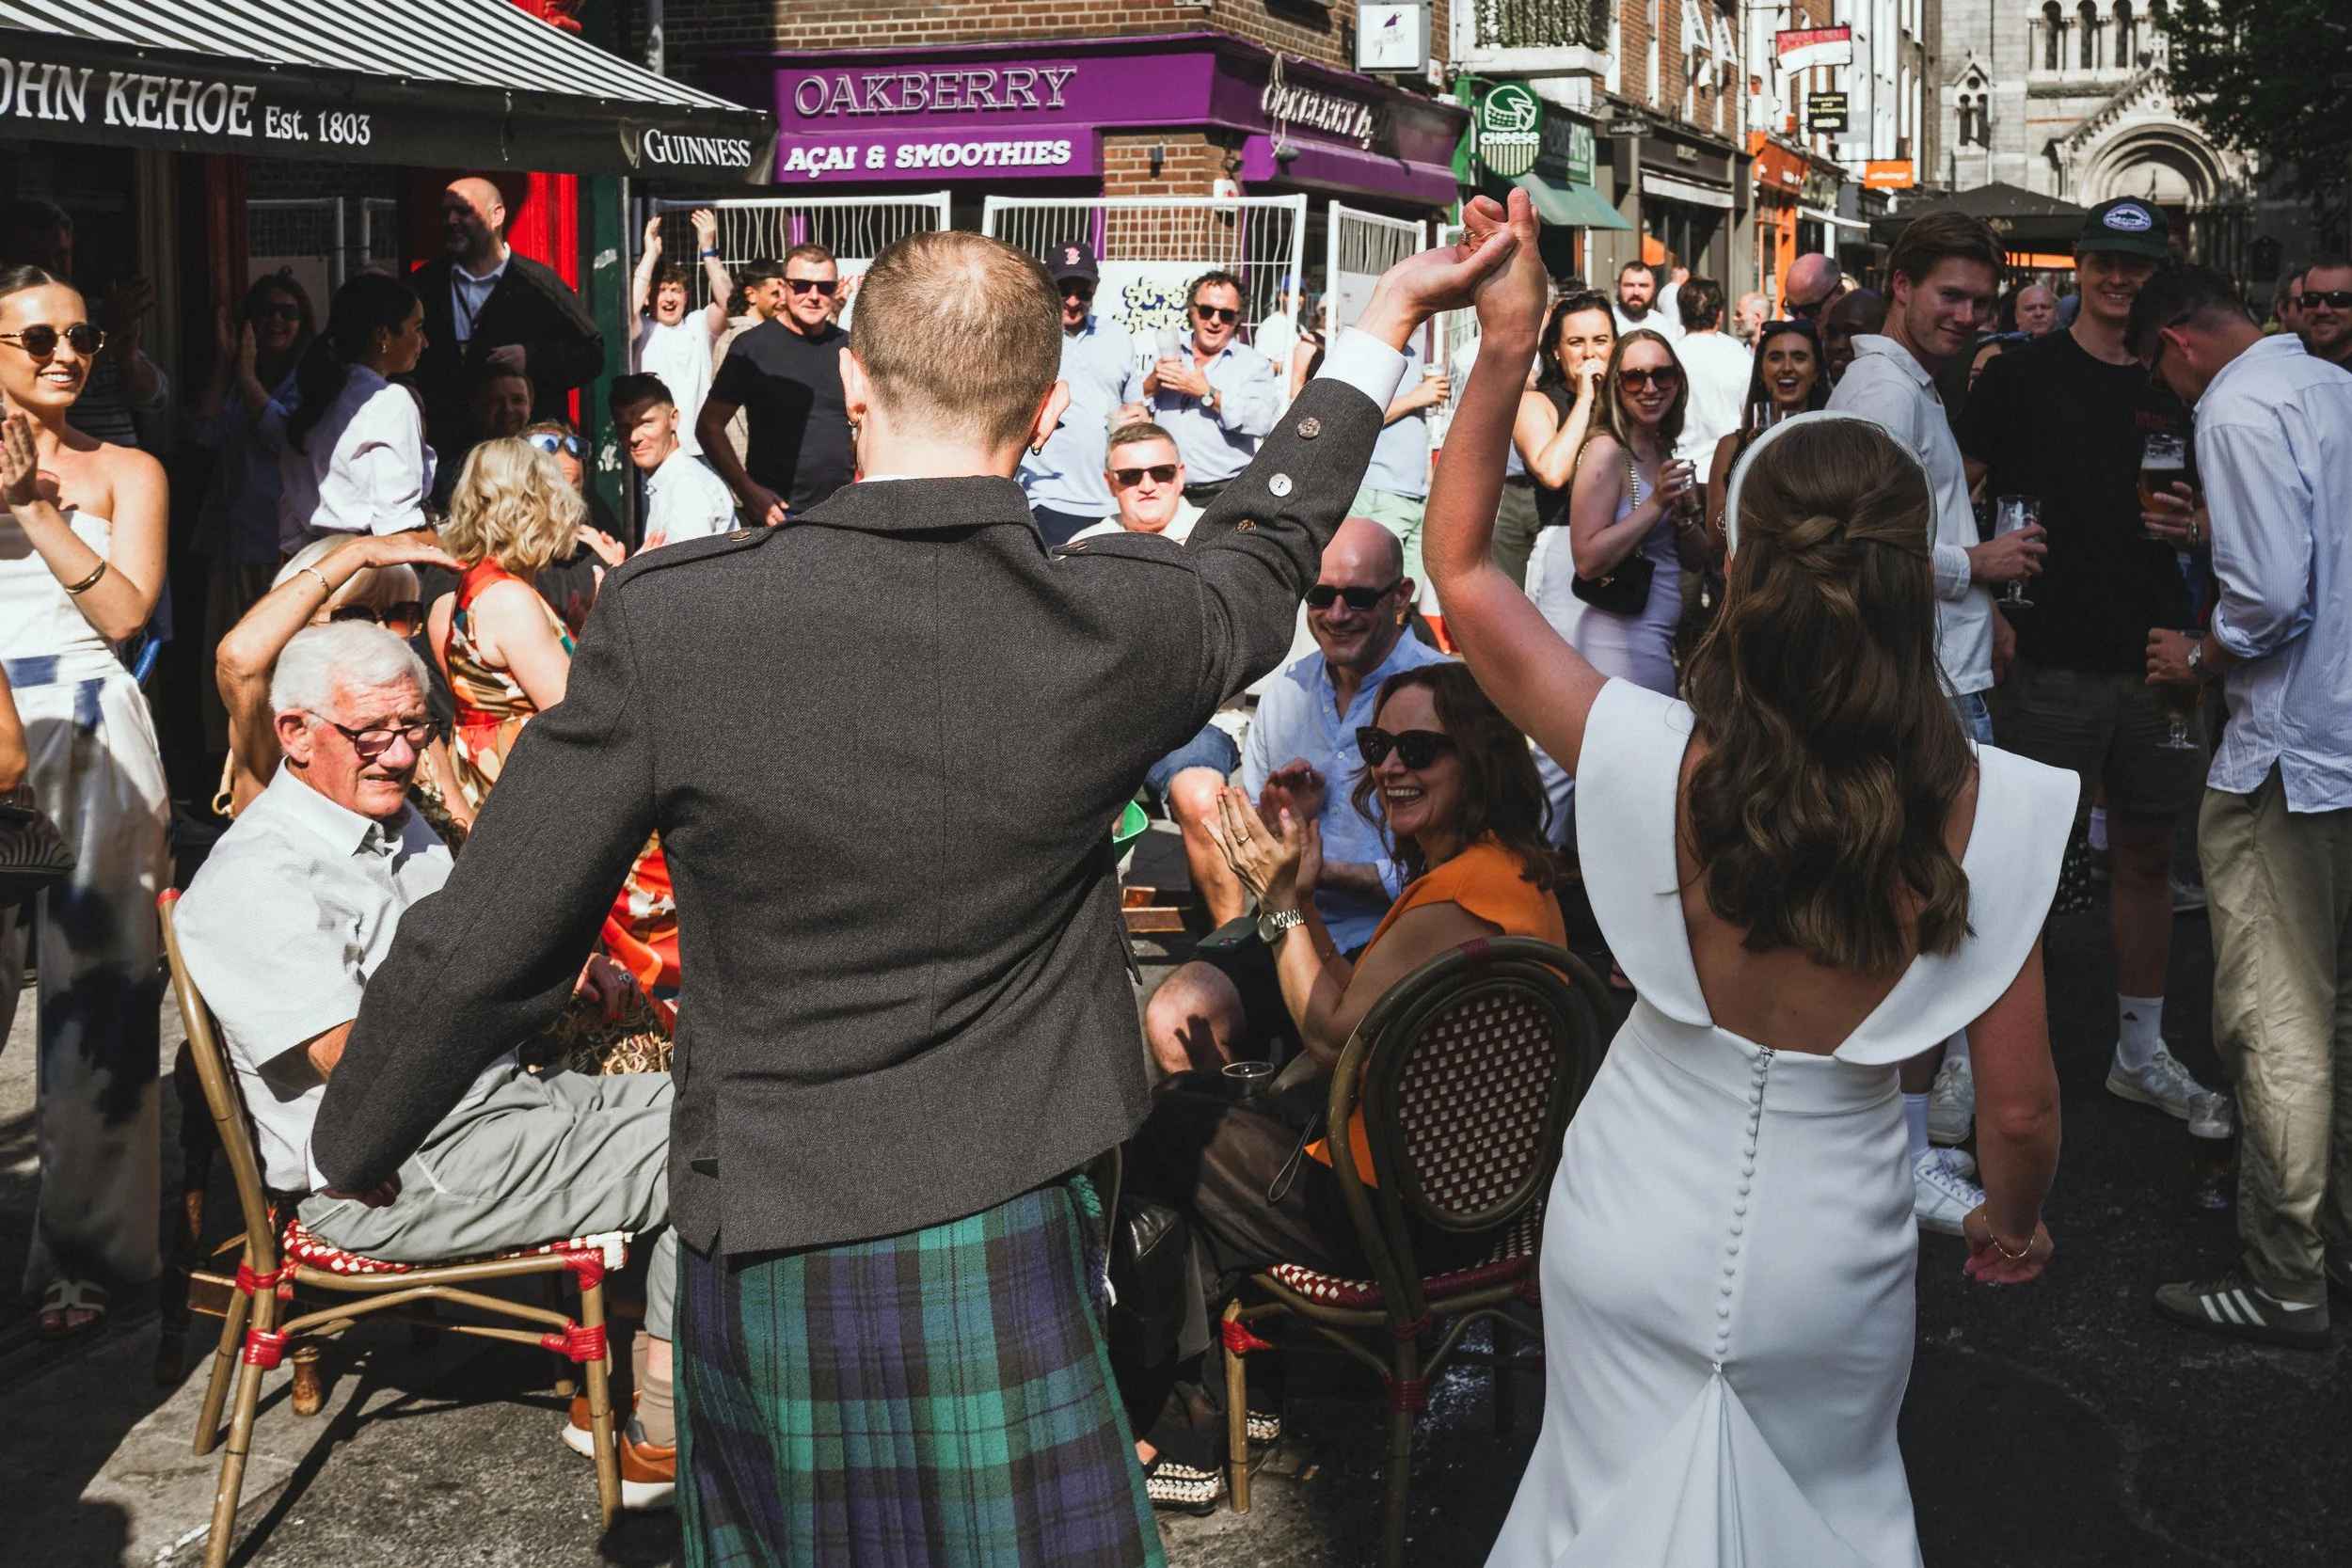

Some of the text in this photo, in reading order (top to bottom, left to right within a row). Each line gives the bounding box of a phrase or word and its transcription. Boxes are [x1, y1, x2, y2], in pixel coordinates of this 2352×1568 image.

[104, 71, 257, 138] KEHOE
[265, 105, 309, 141] Est.
[318, 110, 372, 146] 1803
[794, 66, 1077, 119] OAKBERRY
[644, 129, 752, 167] GUINNESS
[784, 139, 1072, 179] AÇAI & SMOOTHIES
